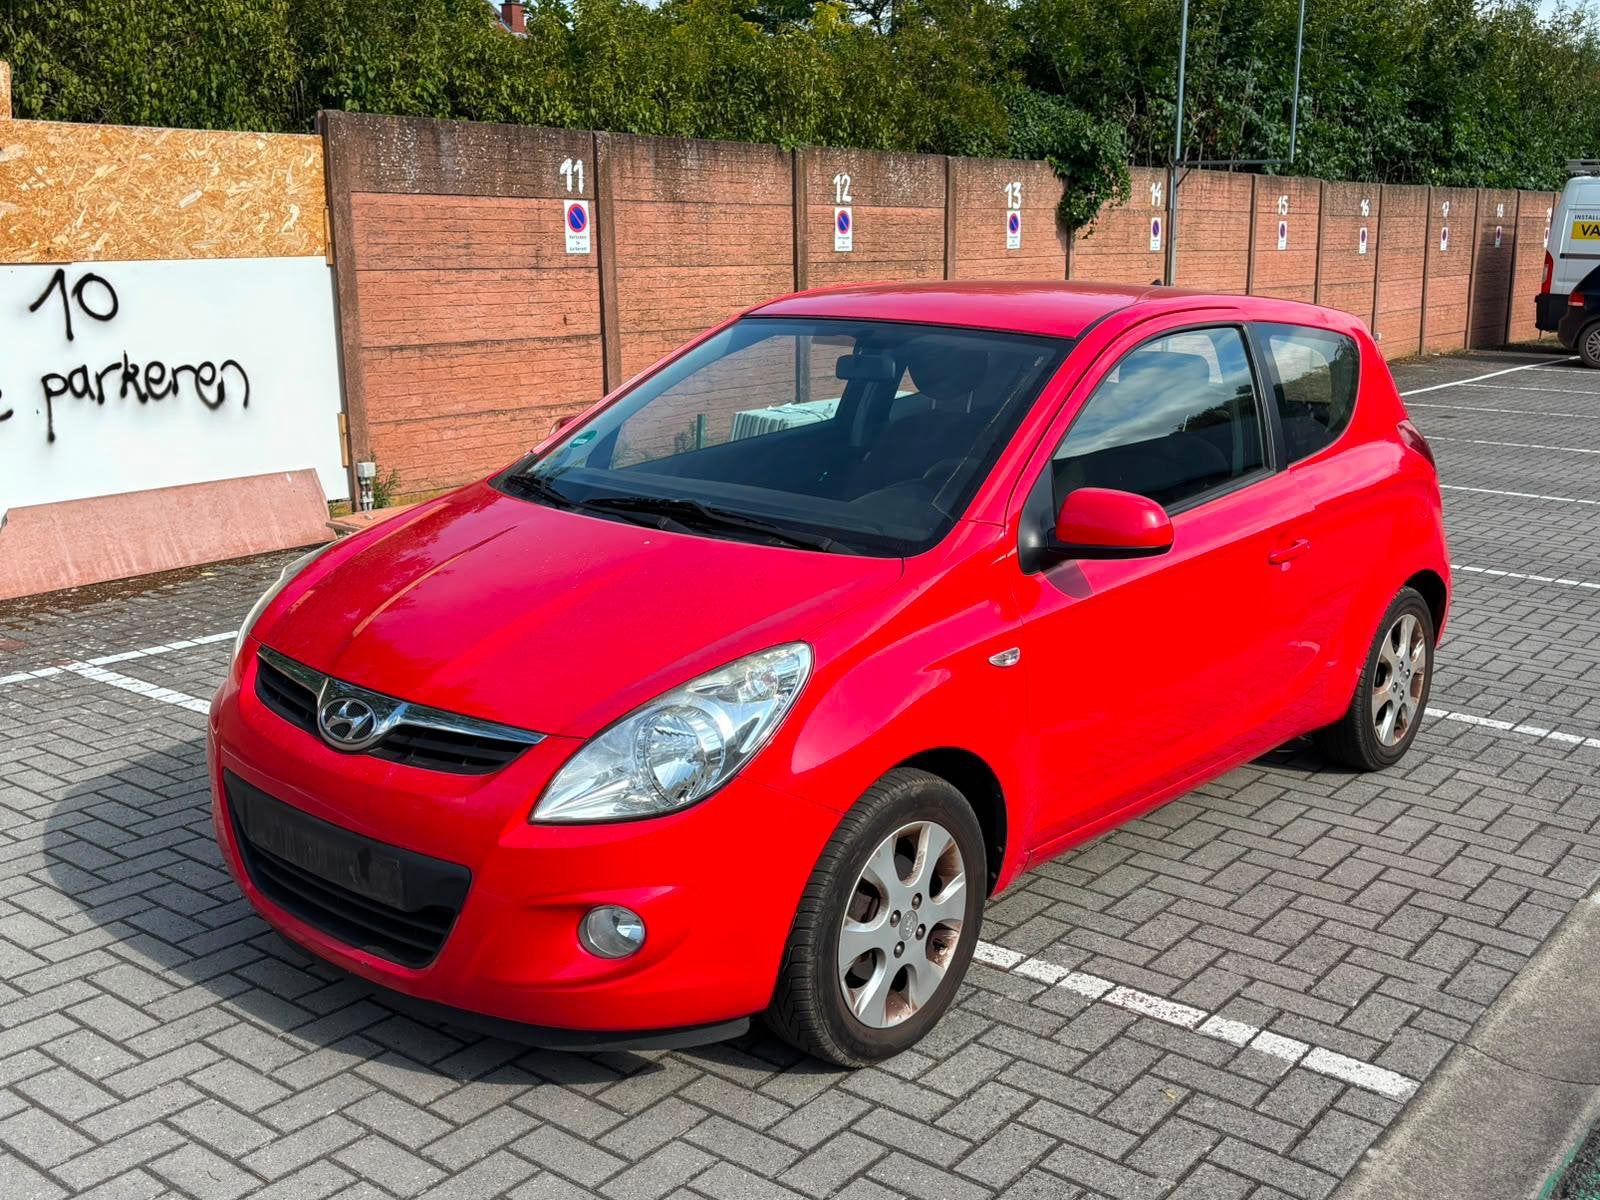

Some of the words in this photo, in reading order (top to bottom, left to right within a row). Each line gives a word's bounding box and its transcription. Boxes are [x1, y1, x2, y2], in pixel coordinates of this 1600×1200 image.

[559, 157, 585, 194] 11
[833, 172, 853, 204] 12
[1004, 181, 1022, 209] 13
[1150, 181, 1162, 207] 14
[1277, 195, 1288, 215] 15
[1361, 199, 1369, 217] 16
[28, 268, 119, 341] 10
[41, 350, 250, 443] parkeren
